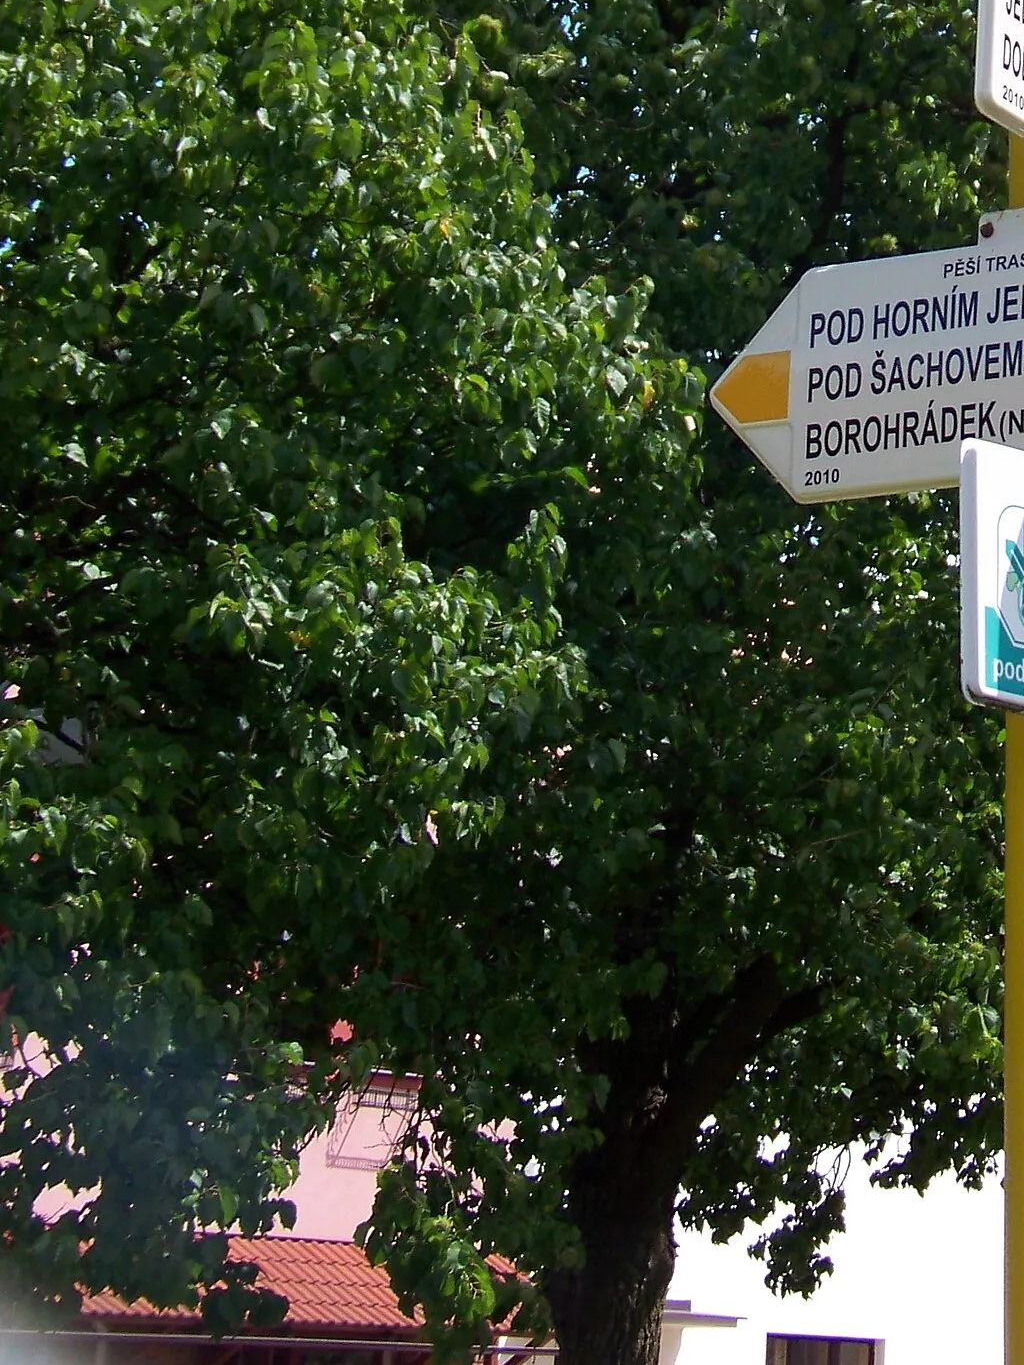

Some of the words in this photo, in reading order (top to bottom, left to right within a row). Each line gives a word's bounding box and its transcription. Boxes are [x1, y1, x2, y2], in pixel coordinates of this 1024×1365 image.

[1002, 85, 1024, 110] 2010
[943, 256, 981, 279] PĚŠÍ
[810, 309, 864, 348] POD
[873, 284, 979, 340] HORNÍM
[808, 365, 861, 403] POD
[870, 340, 1024, 394] ŠACHOVEM
[804, 469, 840, 486] 2010
